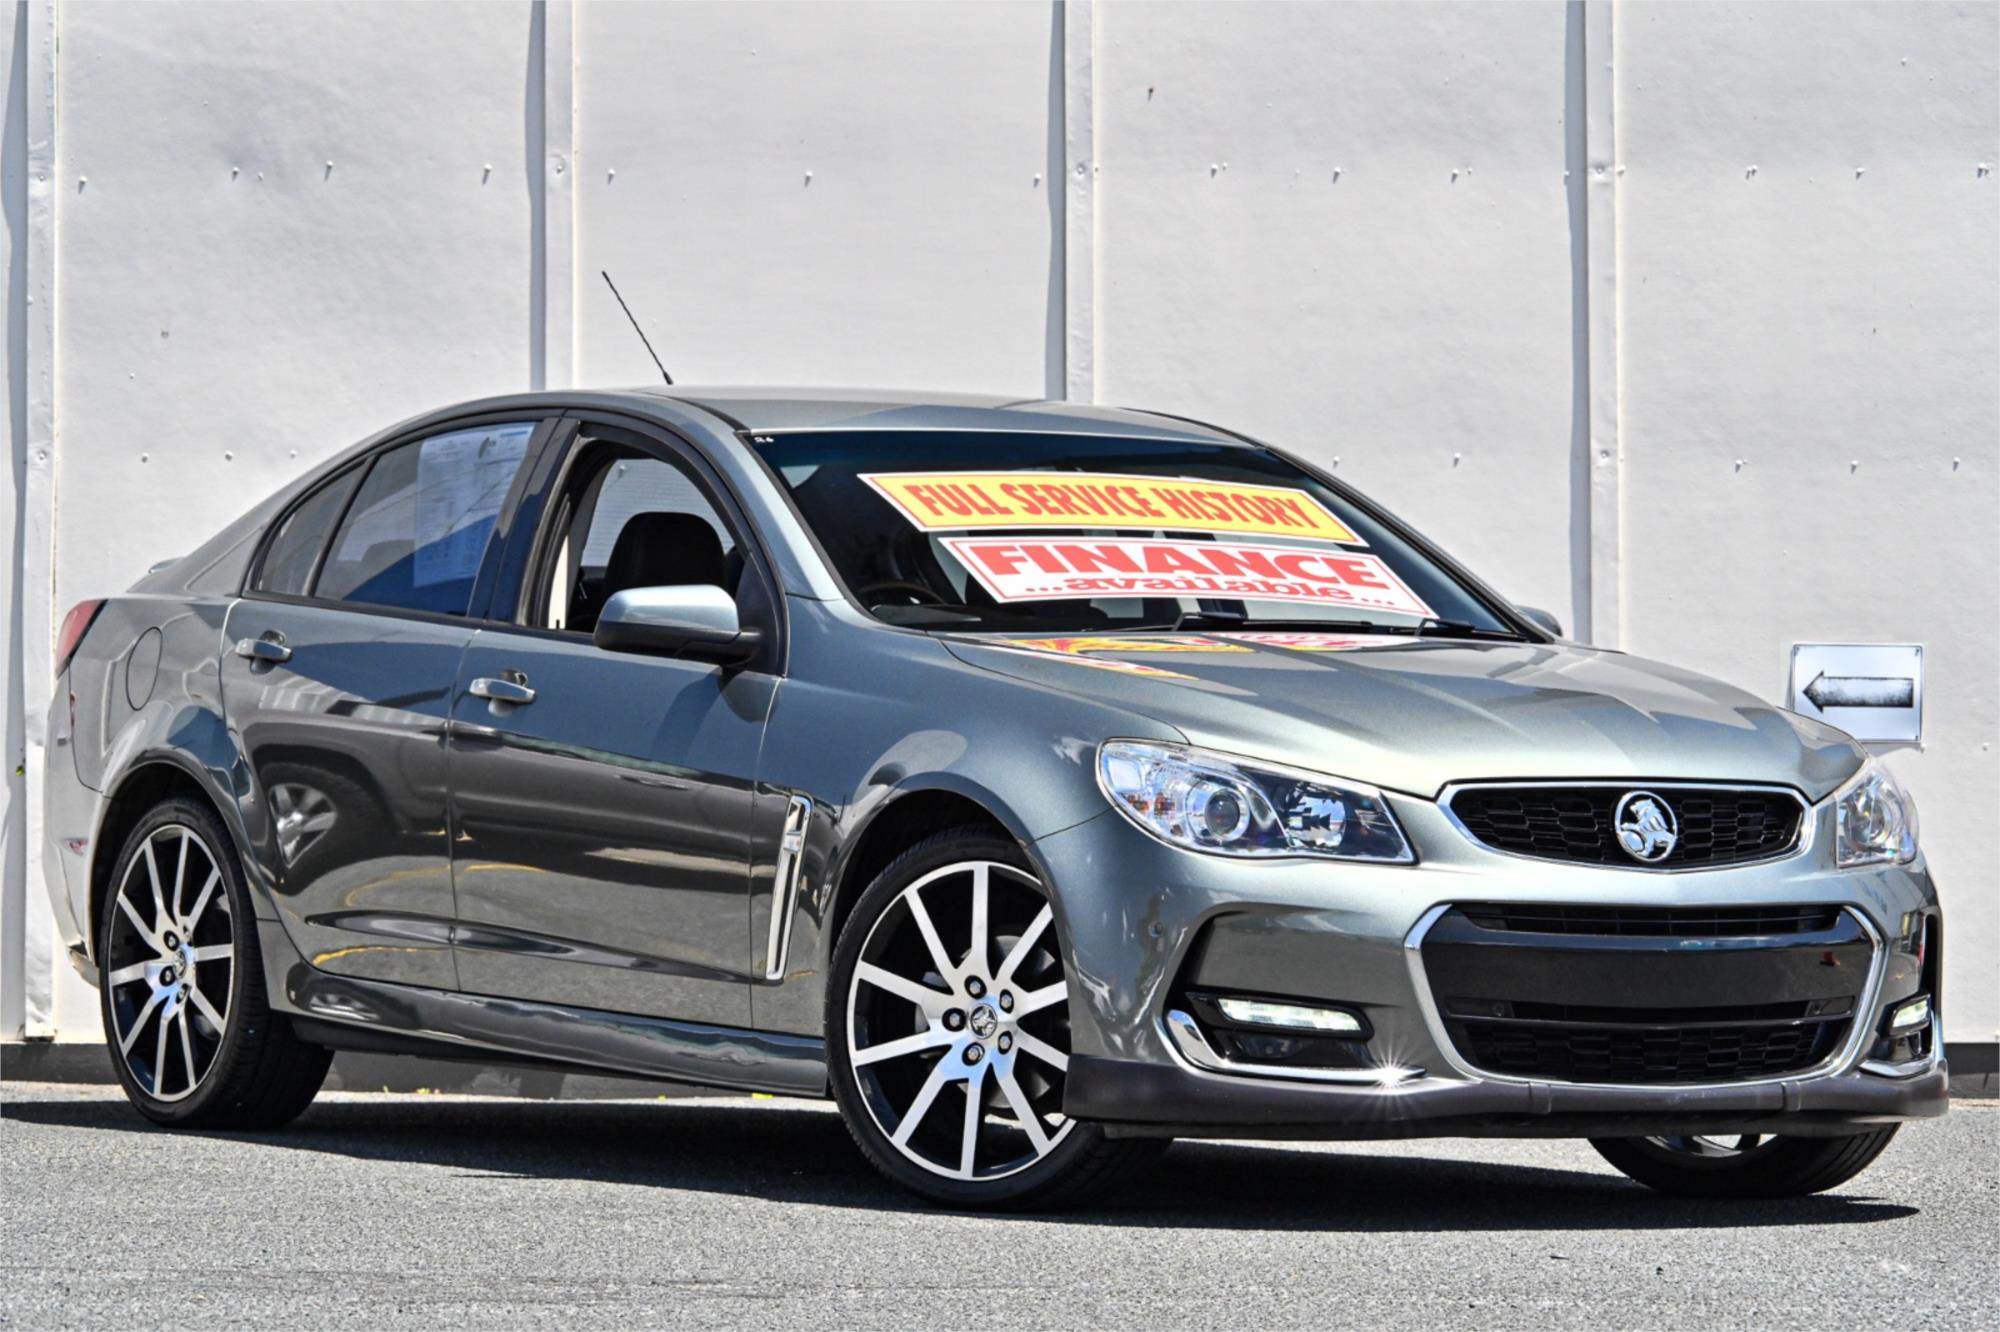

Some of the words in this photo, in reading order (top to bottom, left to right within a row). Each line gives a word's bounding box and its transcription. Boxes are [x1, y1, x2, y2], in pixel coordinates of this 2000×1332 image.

[903, 484, 1015, 516] FULL
[999, 483, 1167, 518] SERVICE
[1149, 487, 1320, 529] HISTORY
[968, 545, 1391, 590] FINANCE
